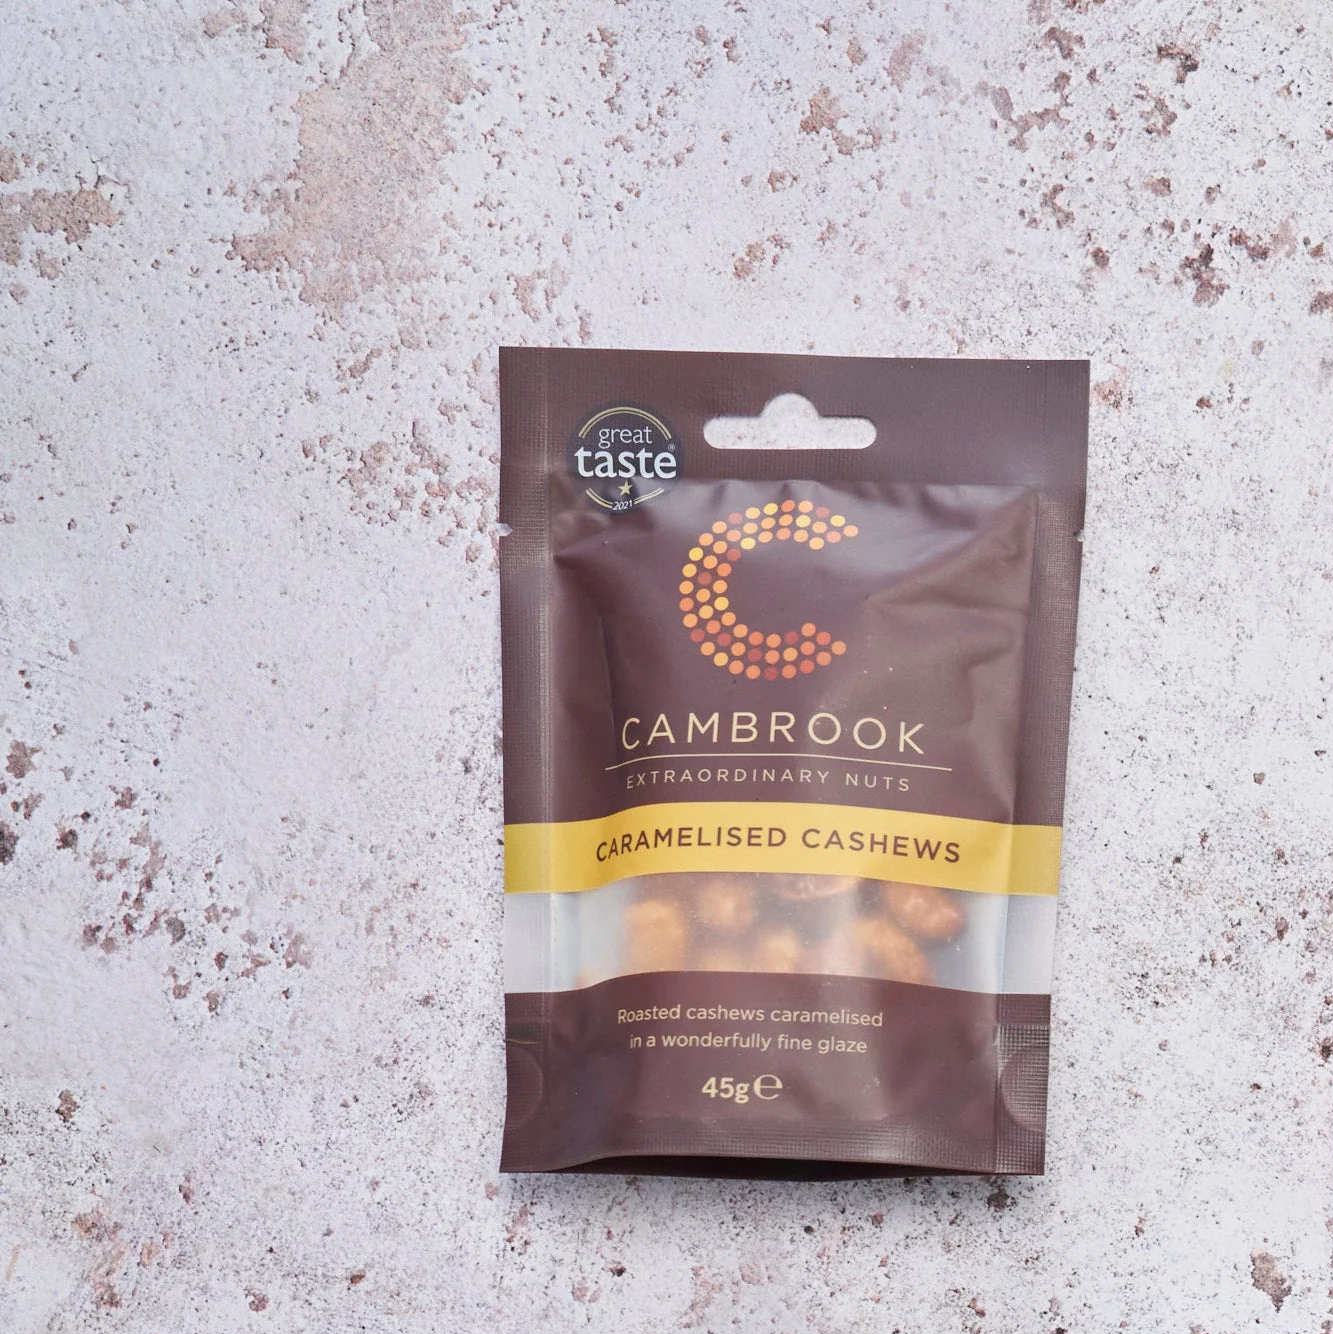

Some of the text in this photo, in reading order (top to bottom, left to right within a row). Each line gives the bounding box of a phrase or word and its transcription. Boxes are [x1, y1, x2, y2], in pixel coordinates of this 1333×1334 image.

[598, 426, 653, 449] great
[612, 500, 633, 511] 2021
[622, 711, 925, 755] CAMBROOK
[626, 768, 911, 792] EXTRAORDINARY NUTS
[596, 827, 961, 864] CARAMELISED CASHEWS
[618, 1004, 883, 1027] Roasted cashews caramelised
[630, 1033, 868, 1054] in a wonderfully fine glaze
